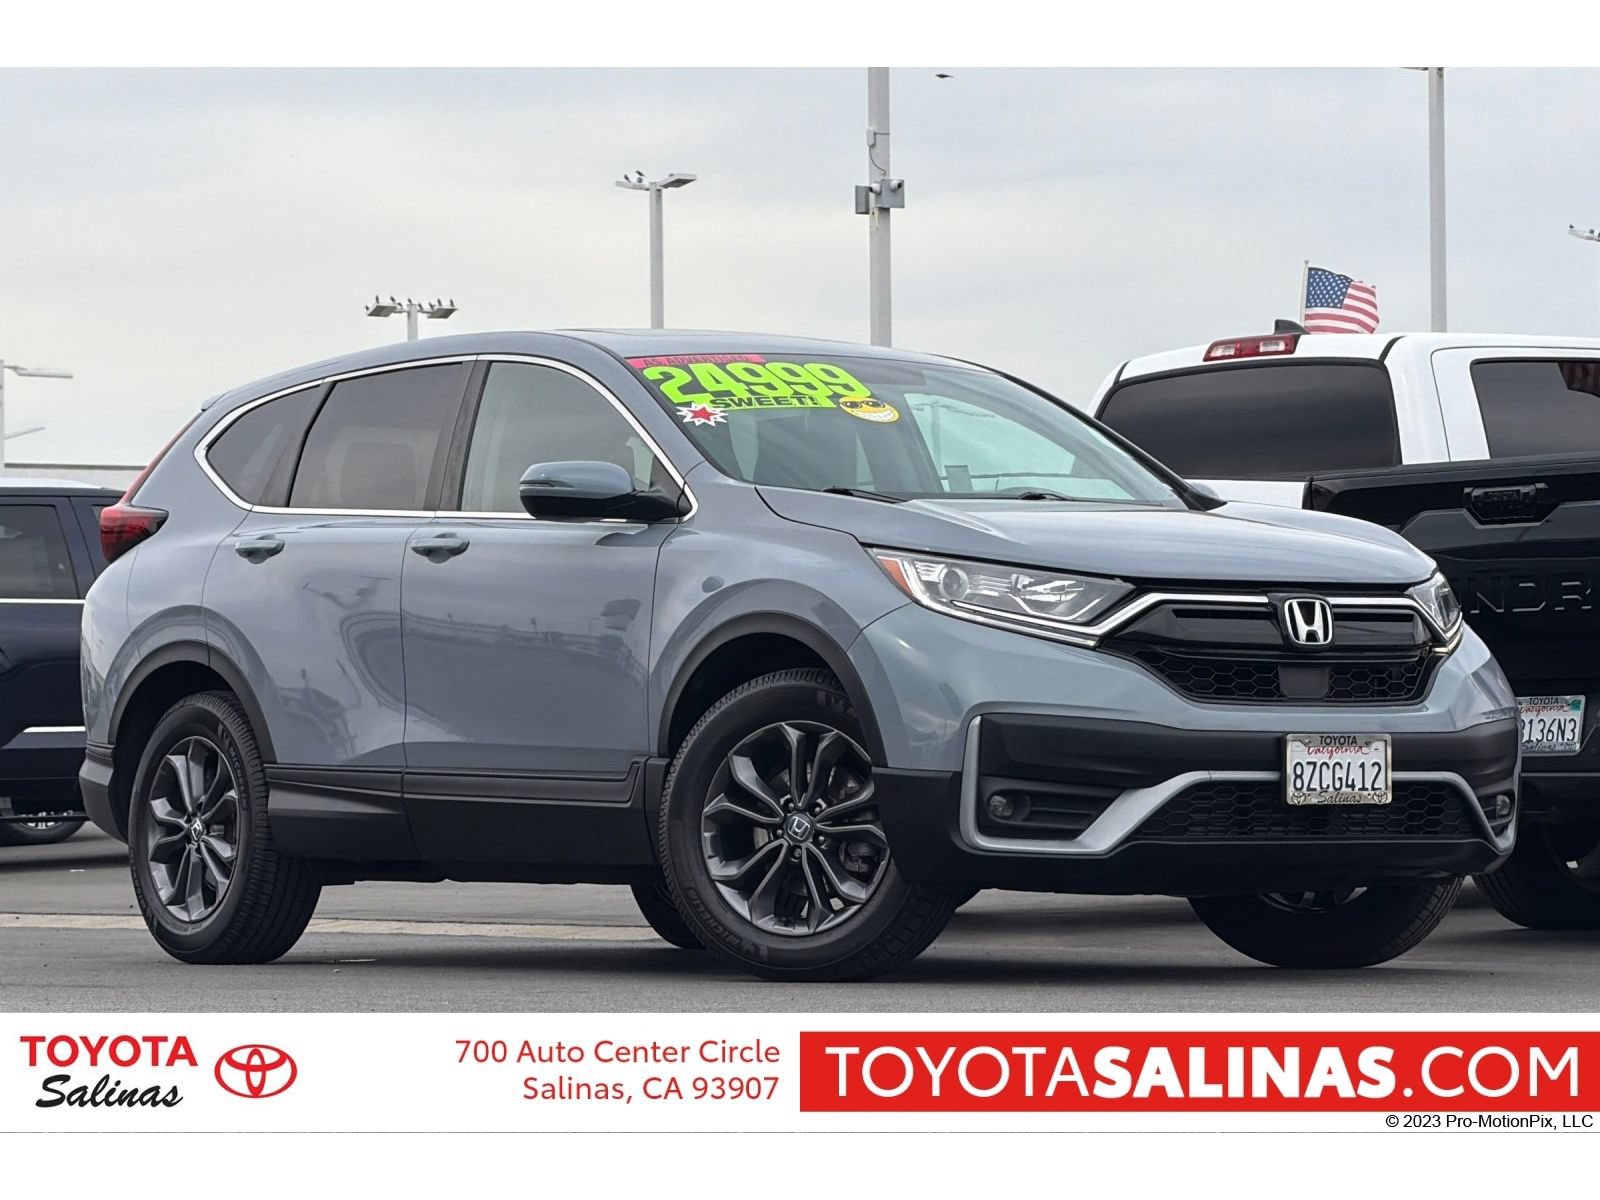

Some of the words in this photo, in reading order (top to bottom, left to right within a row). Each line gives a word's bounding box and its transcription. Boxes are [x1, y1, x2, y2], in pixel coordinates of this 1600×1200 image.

[643, 358, 661, 368] AS
[666, 354, 750, 366] ADVERTISED
[643, 361, 871, 405] 24999
[709, 396, 819, 409] SWEET!
[1528, 697, 1559, 706] TOYOTA
[1520, 705, 1568, 717] California
[1319, 735, 1358, 746] TOYOTA
[1306, 745, 1370, 760] California
[1293, 761, 1383, 792] 8ZCG412
[1317, 790, 1362, 804] Salinas
[686, 889, 742, 946] MICHELIN
